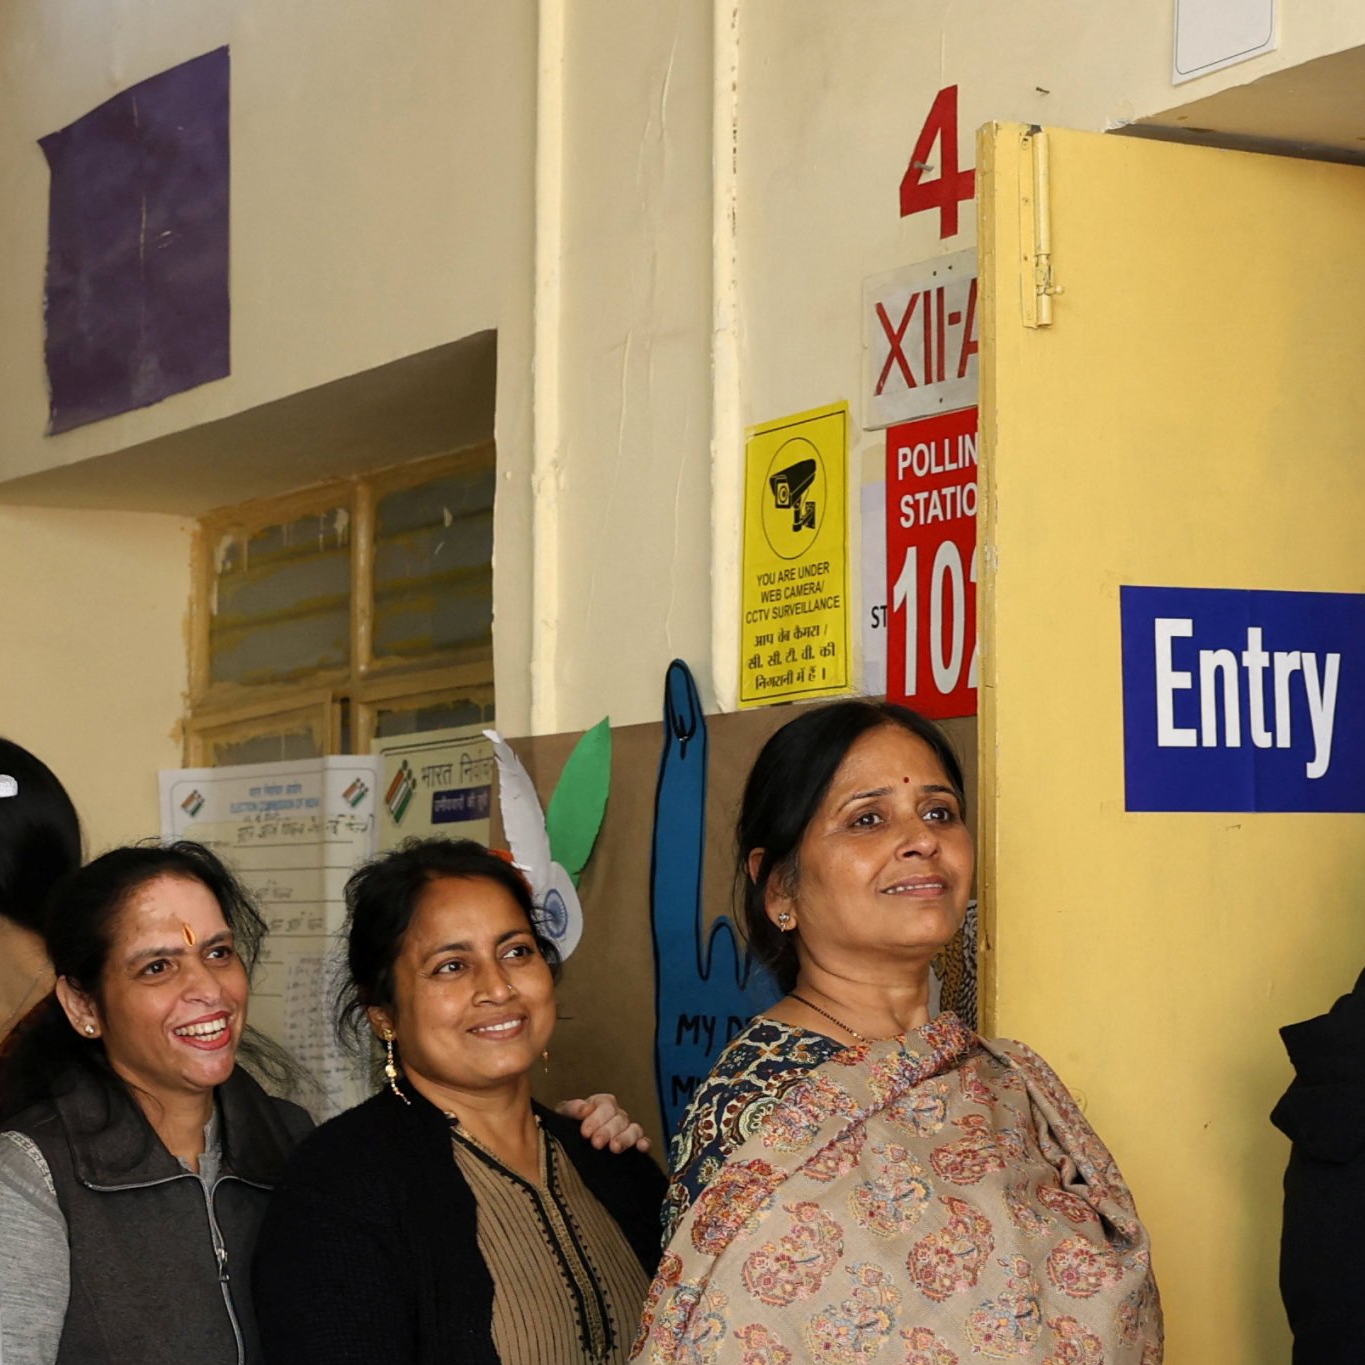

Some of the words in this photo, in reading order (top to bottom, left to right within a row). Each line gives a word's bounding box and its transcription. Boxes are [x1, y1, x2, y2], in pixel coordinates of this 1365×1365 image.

[899, 85, 975, 239] 4
[898, 432, 978, 481] POLLIN
[900, 482, 978, 528] STATIO
[757, 573, 776, 587] YOU
[778, 567, 796, 582] ARE
[798, 561, 830, 579] UNDER
[761, 589, 781, 603] WEB
[784, 580, 825, 600] CAMERA/
[746, 608, 770, 624] CCTV
[773, 595, 840, 619] SURVEILLANCE
[893, 540, 978, 696] 10
[755, 633, 774, 648] आप
[820, 641, 836, 658] की
[755, 669, 793, 690] निगरानी
[1155, 618, 1341, 779] Entry
[676, 1014, 716, 1057] MY
